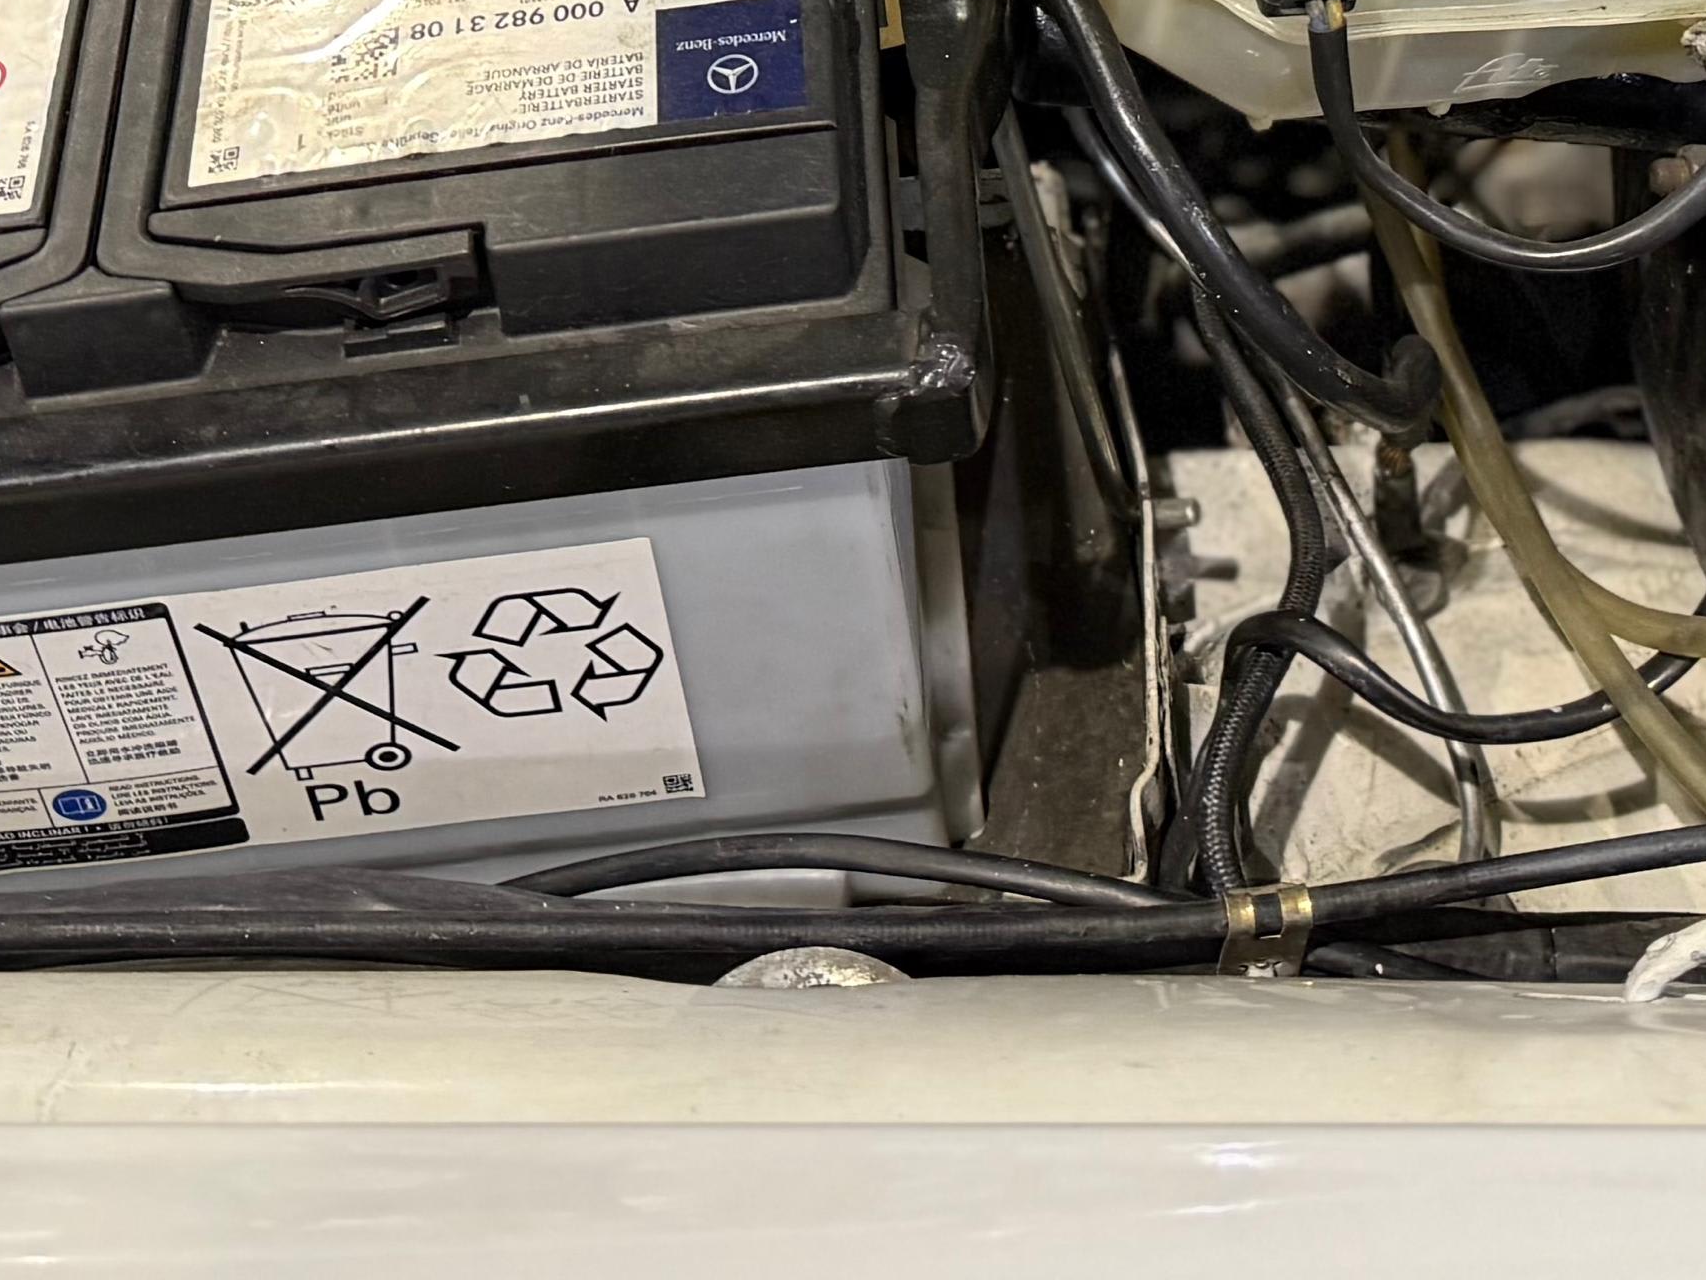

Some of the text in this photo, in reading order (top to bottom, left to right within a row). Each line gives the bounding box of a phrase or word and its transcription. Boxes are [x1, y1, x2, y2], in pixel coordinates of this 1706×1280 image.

[493, 6, 544, 30] 982
[553, 0, 603, 22] 000
[409, 19, 443, 40] 08
[455, 13, 485, 34] 31
[675, 28, 786, 55] Mercedes-Benz
[483, 51, 643, 81] BATERÍA DE ARRANQUE
[557, 71, 575, 84] DE
[579, 63, 643, 81] BATTERIE
[518, 75, 643, 102] STARTER BATTERY
[518, 88, 643, 114] STARTERBATTERIE
[540, 105, 643, 128] Mercedes-Benz
[295, 132, 306, 151] 1
[304, 776, 404, 821] Pb
